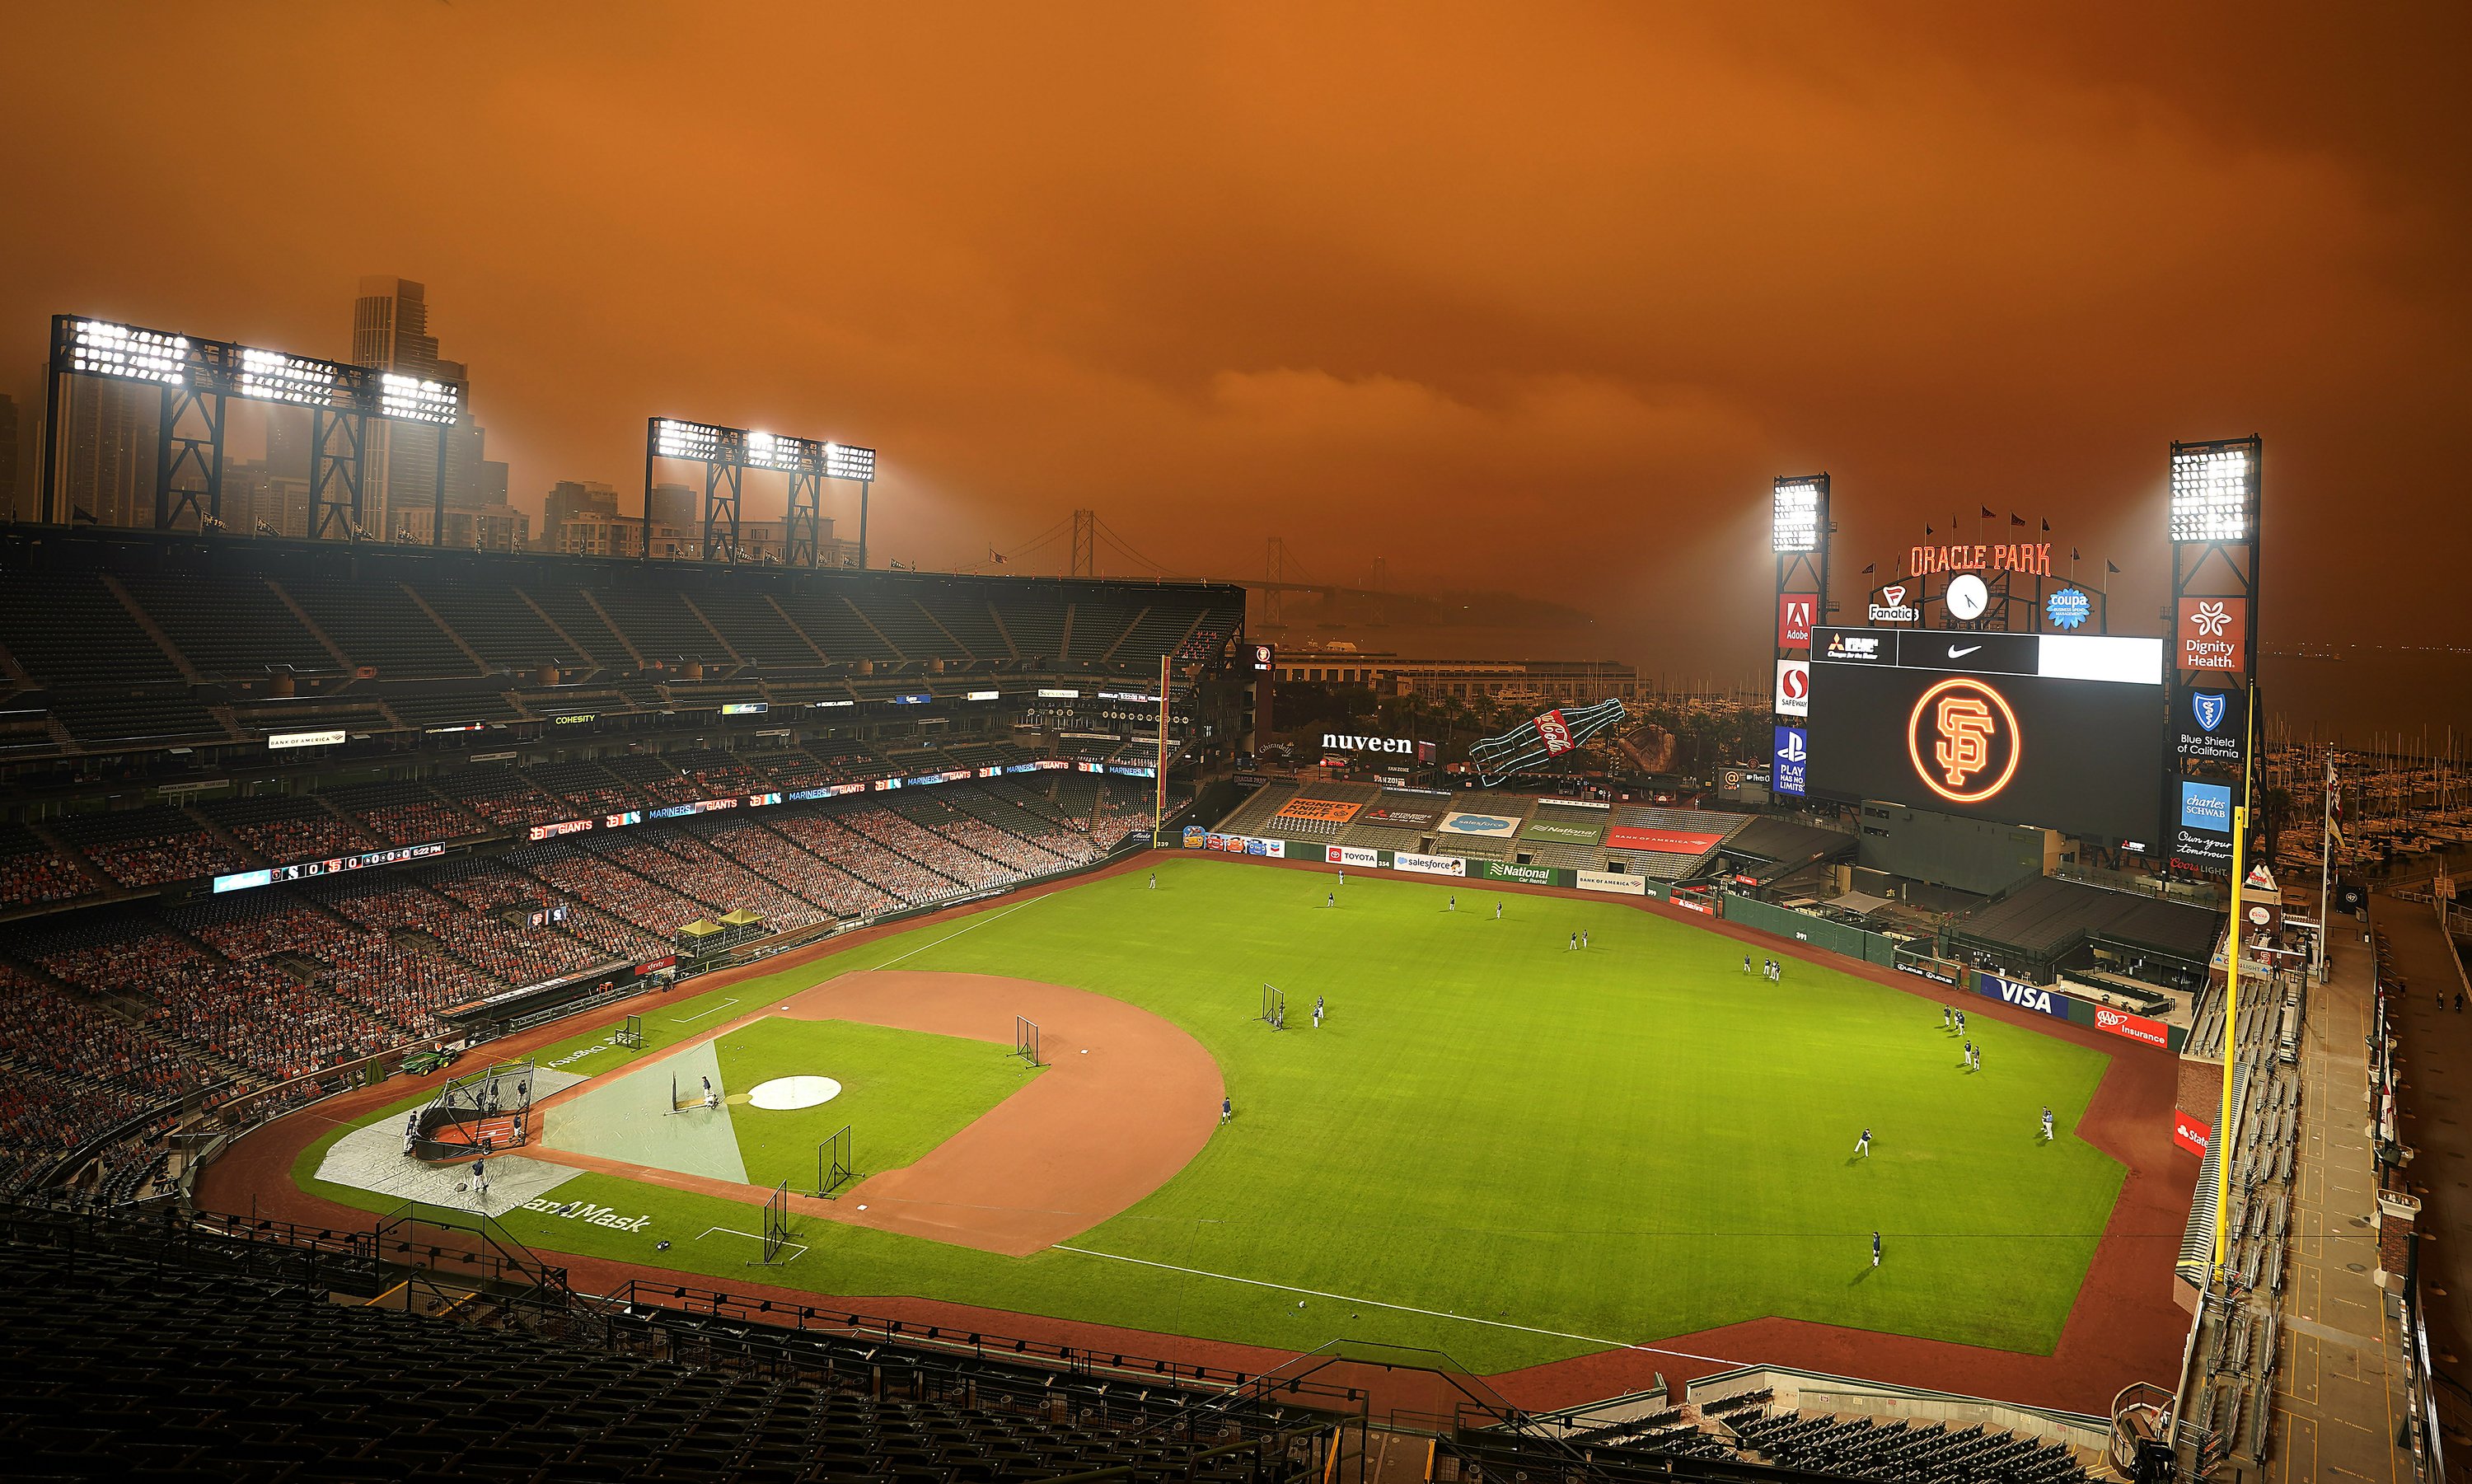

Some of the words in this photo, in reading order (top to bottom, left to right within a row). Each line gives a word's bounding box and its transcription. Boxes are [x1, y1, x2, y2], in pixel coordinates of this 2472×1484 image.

[1911, 545, 1987, 577] ORACLE
[1994, 543, 2052, 577] PARK
[2051, 596, 2087, 609] coupa
[1870, 606, 1918, 620] Fanatics
[1786, 630, 1809, 640] Adobe
[2186, 639, 2236, 656] Dignity
[2188, 655, 2236, 668] Health.
[1781, 699, 1808, 708] SAFEWAY
[555, 714, 595, 724] COHESITY
[1322, 733, 1412, 754] nuveen
[2180, 734, 2203, 744] Blue
[2204, 736, 2236, 748] Shield
[1258, 742, 1293, 756] Ghirardelli
[2177, 744, 2187, 753] of
[2189, 745, 2239, 758] California
[1007, 763, 1034, 773] MARINERS
[1042, 761, 1070, 770] GIANTS
[1109, 766, 1142, 775] MARINERS
[1781, 764, 1805, 776] PLAY
[907, 775, 939, 785] MARINERS
[949, 770, 971, 779] GIANTS
[1780, 774, 1793, 782] HAS
[789, 788, 827, 801] MARINERS
[839, 784, 865, 794] GIANTS
[1780, 781, 1805, 792] LIMITS.
[1288, 804, 1333, 813] KNIFE
[1293, 800, 1356, 810] MONKEY
[2186, 794, 2226, 810] charles
[649, 805, 691, 819] MARINERS
[706, 799, 737, 810] GIANTS
[1283, 808, 1330, 817] FIGHT
[2186, 805, 2226, 818] SCHWAB
[558, 820, 592, 835] GIANTS
[1547, 826, 1597, 836] National
[2178, 831, 2203, 843] Own
[2203, 838, 2232, 850] your
[430, 845, 442, 854] PM
[2176, 844, 2233, 859] tomorrow
[348, 858, 357, 868] 0
[1344, 852, 1375, 863] TOYOTA
[1407, 858, 1450, 870] salesforce
[309, 864, 318, 875] 0
[1503, 864, 1550, 879] National
[2170, 857, 2200, 872] Coors
[2200, 865, 2227, 876] LIGHT
[1795, 931, 1807, 941] 391
[647, 961, 665, 971] xfinity
[2243, 964, 2259, 972] LIGHT
[1997, 978, 2052, 1014] VISA
[2099, 1011, 2117, 1025] AAA
[2121, 1024, 2165, 1044] Insurance
[547, 1045, 608, 1068] Dignity
[2189, 1130, 2209, 1149] State
[522, 1198, 561, 1212] ar
[567, 1203, 651, 1234] Mask
